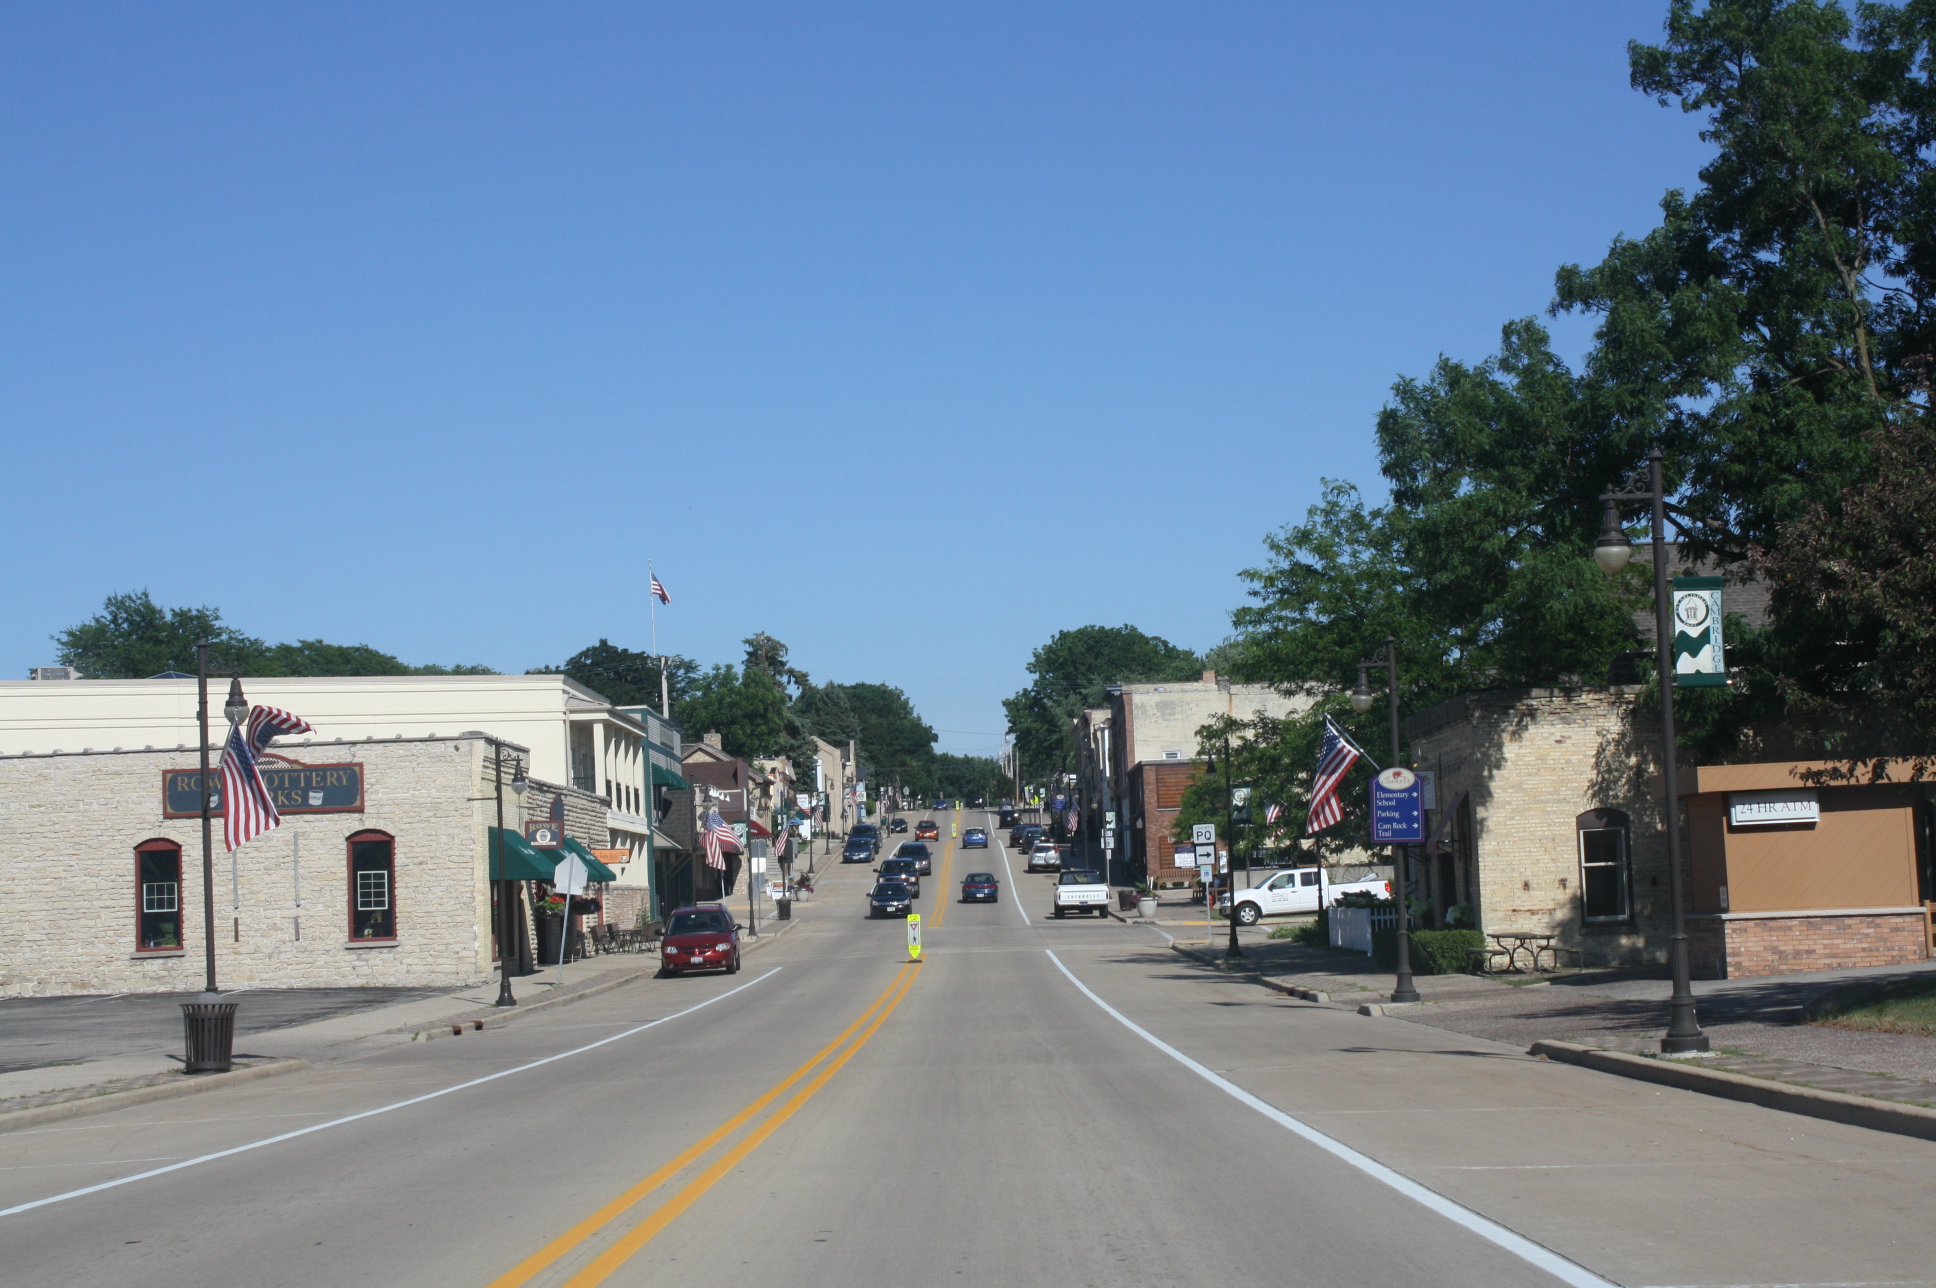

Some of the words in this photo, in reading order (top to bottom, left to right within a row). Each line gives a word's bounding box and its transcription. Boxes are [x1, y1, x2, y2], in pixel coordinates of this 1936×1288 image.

[1710, 591, 1722, 673] CAMBRIDGE
[176, 775, 223, 792] ROW
[263, 770, 351, 789] OTTERY
[1376, 791, 1409, 799] Elementary
[1740, 803, 1753, 814] 24
[1757, 802, 1777, 813] HR
[1781, 800, 1812, 812] ATM
[529, 823, 559, 833] ROWE
[1196, 830, 1212, 841] PQ
